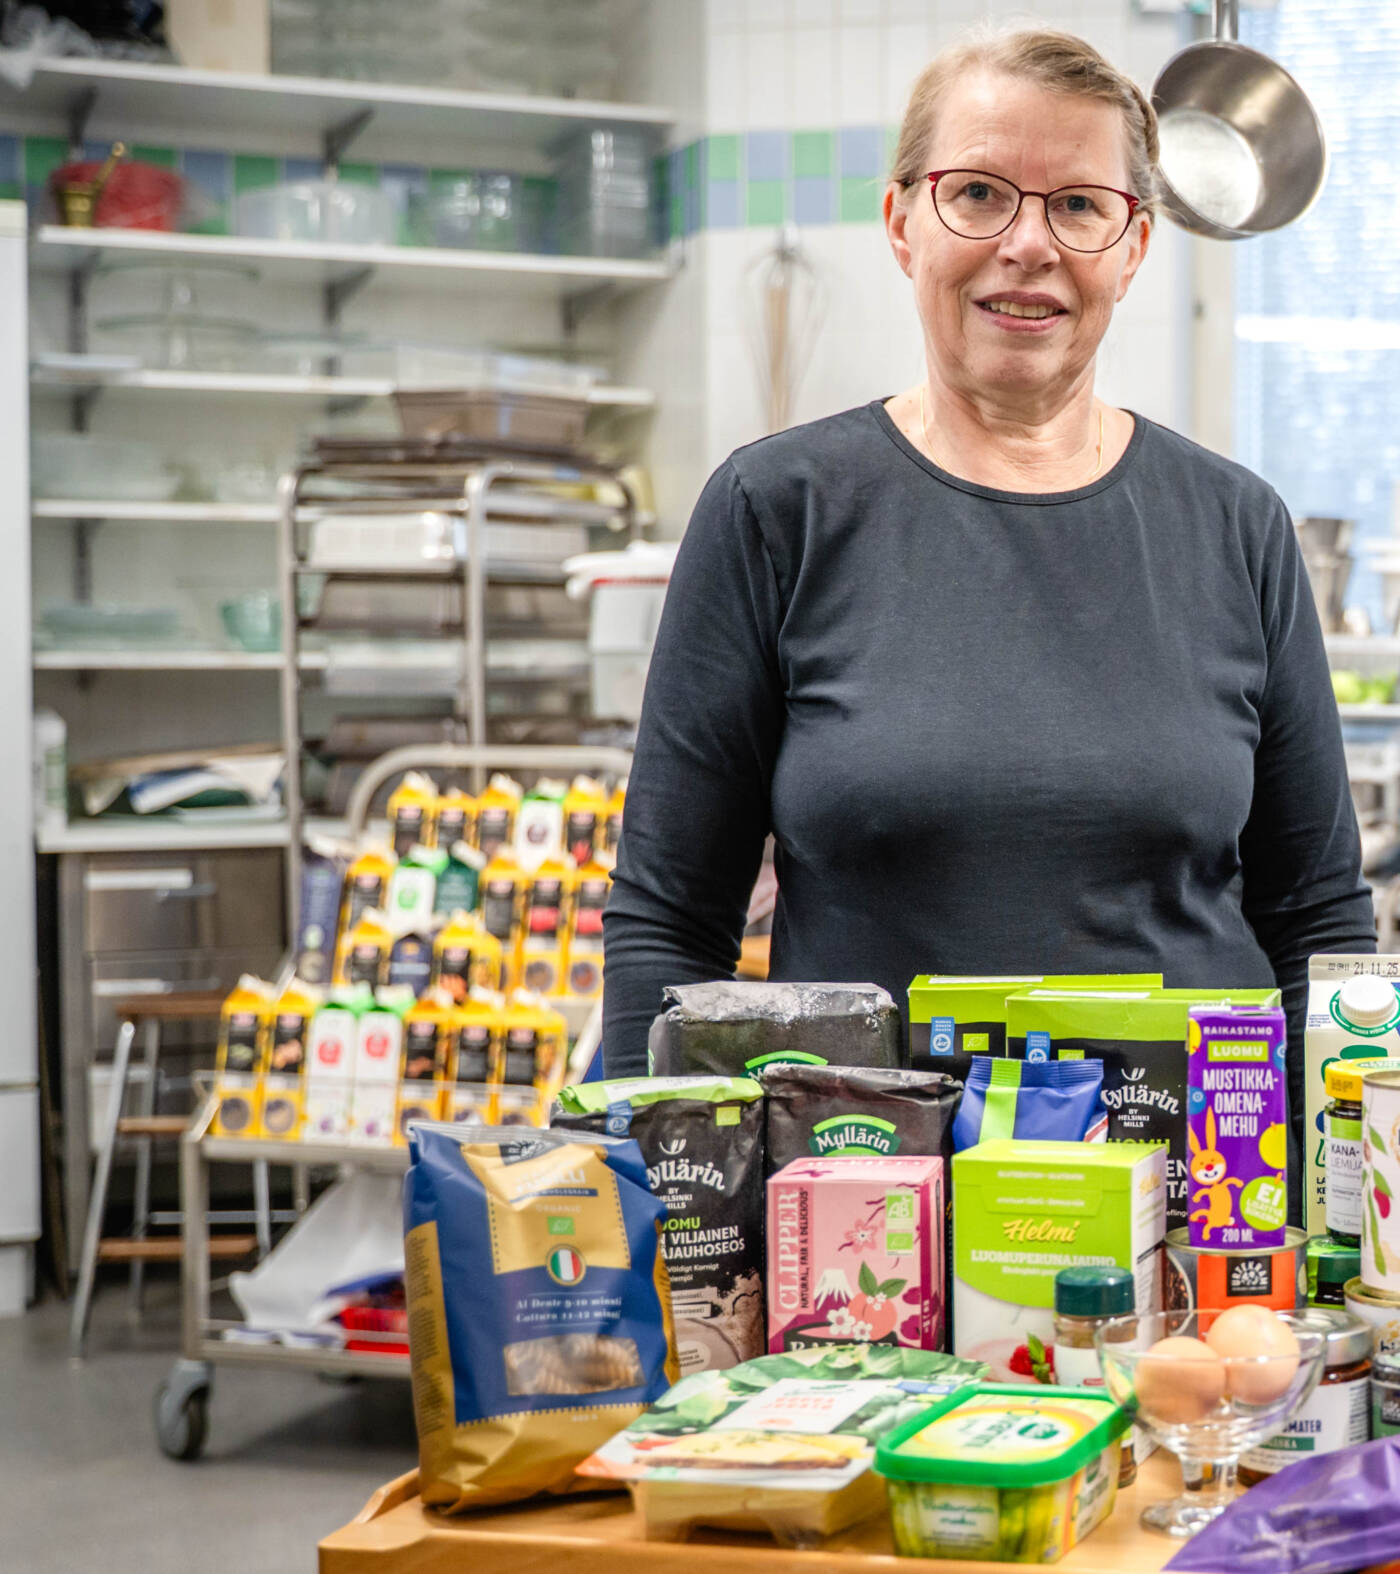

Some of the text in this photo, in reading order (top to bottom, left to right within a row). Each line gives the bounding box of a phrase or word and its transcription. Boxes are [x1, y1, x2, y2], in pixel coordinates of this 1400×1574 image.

[1353, 961, 1400, 976] 21.11.25
[1203, 1026, 1273, 1036] RAIKASTAMO
[1212, 1045, 1263, 1057] LUOMU
[1202, 1068, 1279, 1091] MUSTIKKA-
[1213, 1091, 1267, 1114] OMENA-
[1117, 1114, 1150, 1122] HELSINKI
[1219, 1115, 1258, 1137] MEHU
[815, 1124, 891, 1153] Myllärin
[646, 1158, 725, 1191] yllärin
[667, 1187, 680, 1195] BY
[1256, 1182, 1283, 1207] EI
[671, 1225, 739, 1245] VILJAINEN
[1002, 1218, 1081, 1243] Helmi
[1222, 1228, 1240, 1243] 200
[777, 1187, 800, 1310] CLIPPER
[800, 1244, 810, 1267] FAIR
[970, 1249, 1117, 1267] LUOMUPERUNAJAUHO
